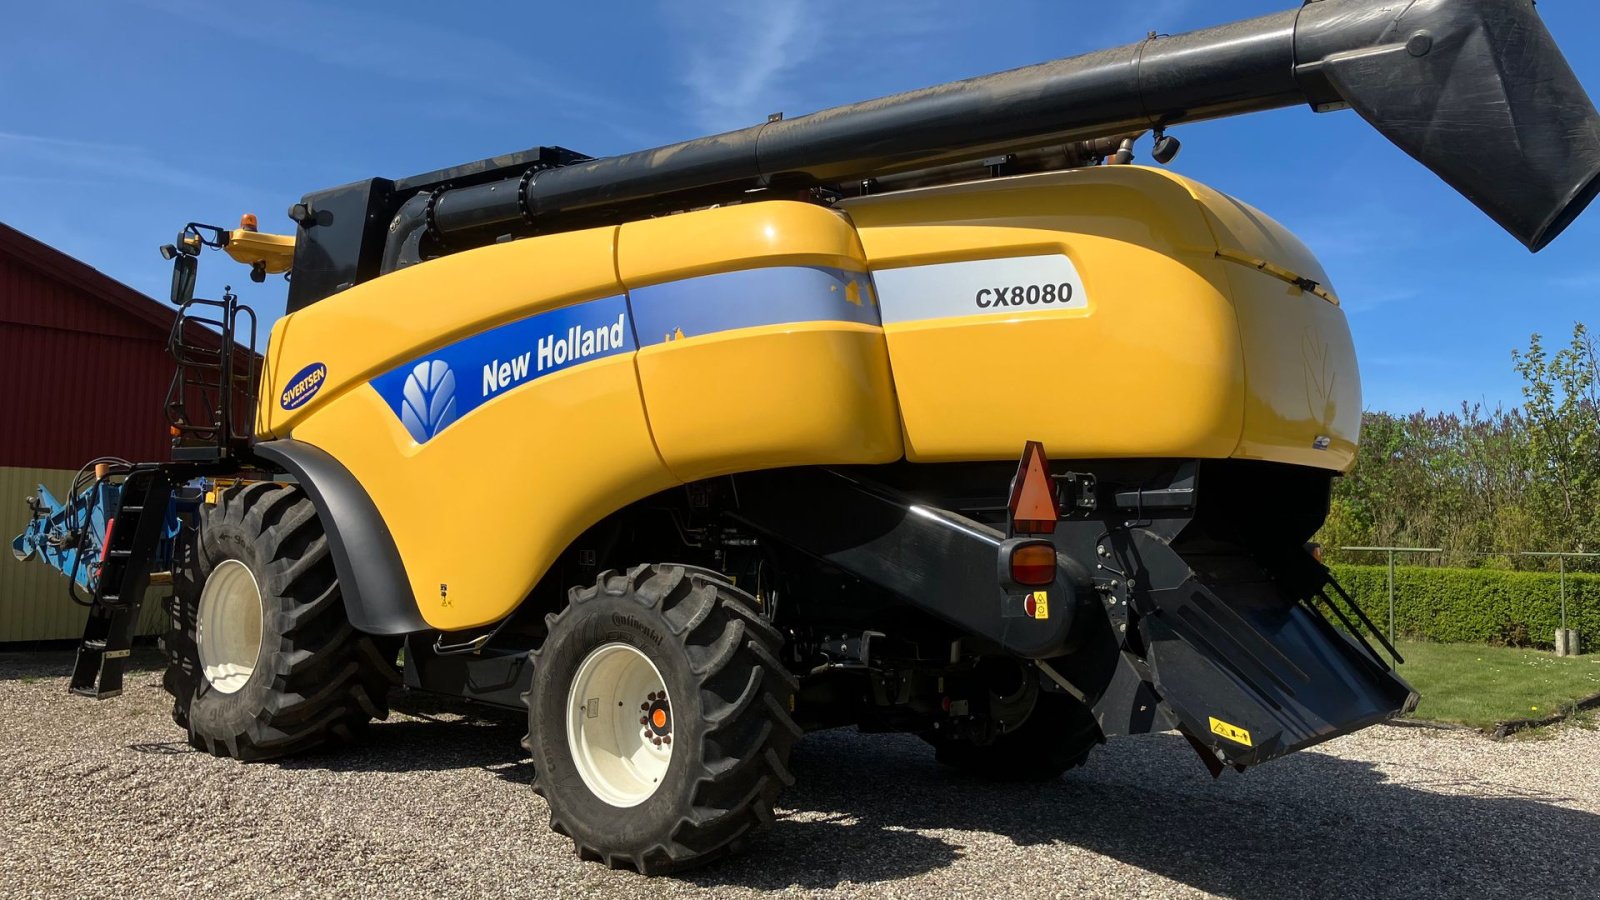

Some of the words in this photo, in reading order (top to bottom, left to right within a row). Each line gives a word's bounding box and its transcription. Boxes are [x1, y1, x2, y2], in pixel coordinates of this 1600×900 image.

[976, 283, 1073, 308] CX8080
[483, 359, 531, 397] New
[537, 313, 625, 372] Holland
[283, 366, 325, 406] SIVERTSEN
[612, 612, 663, 646] Continental
